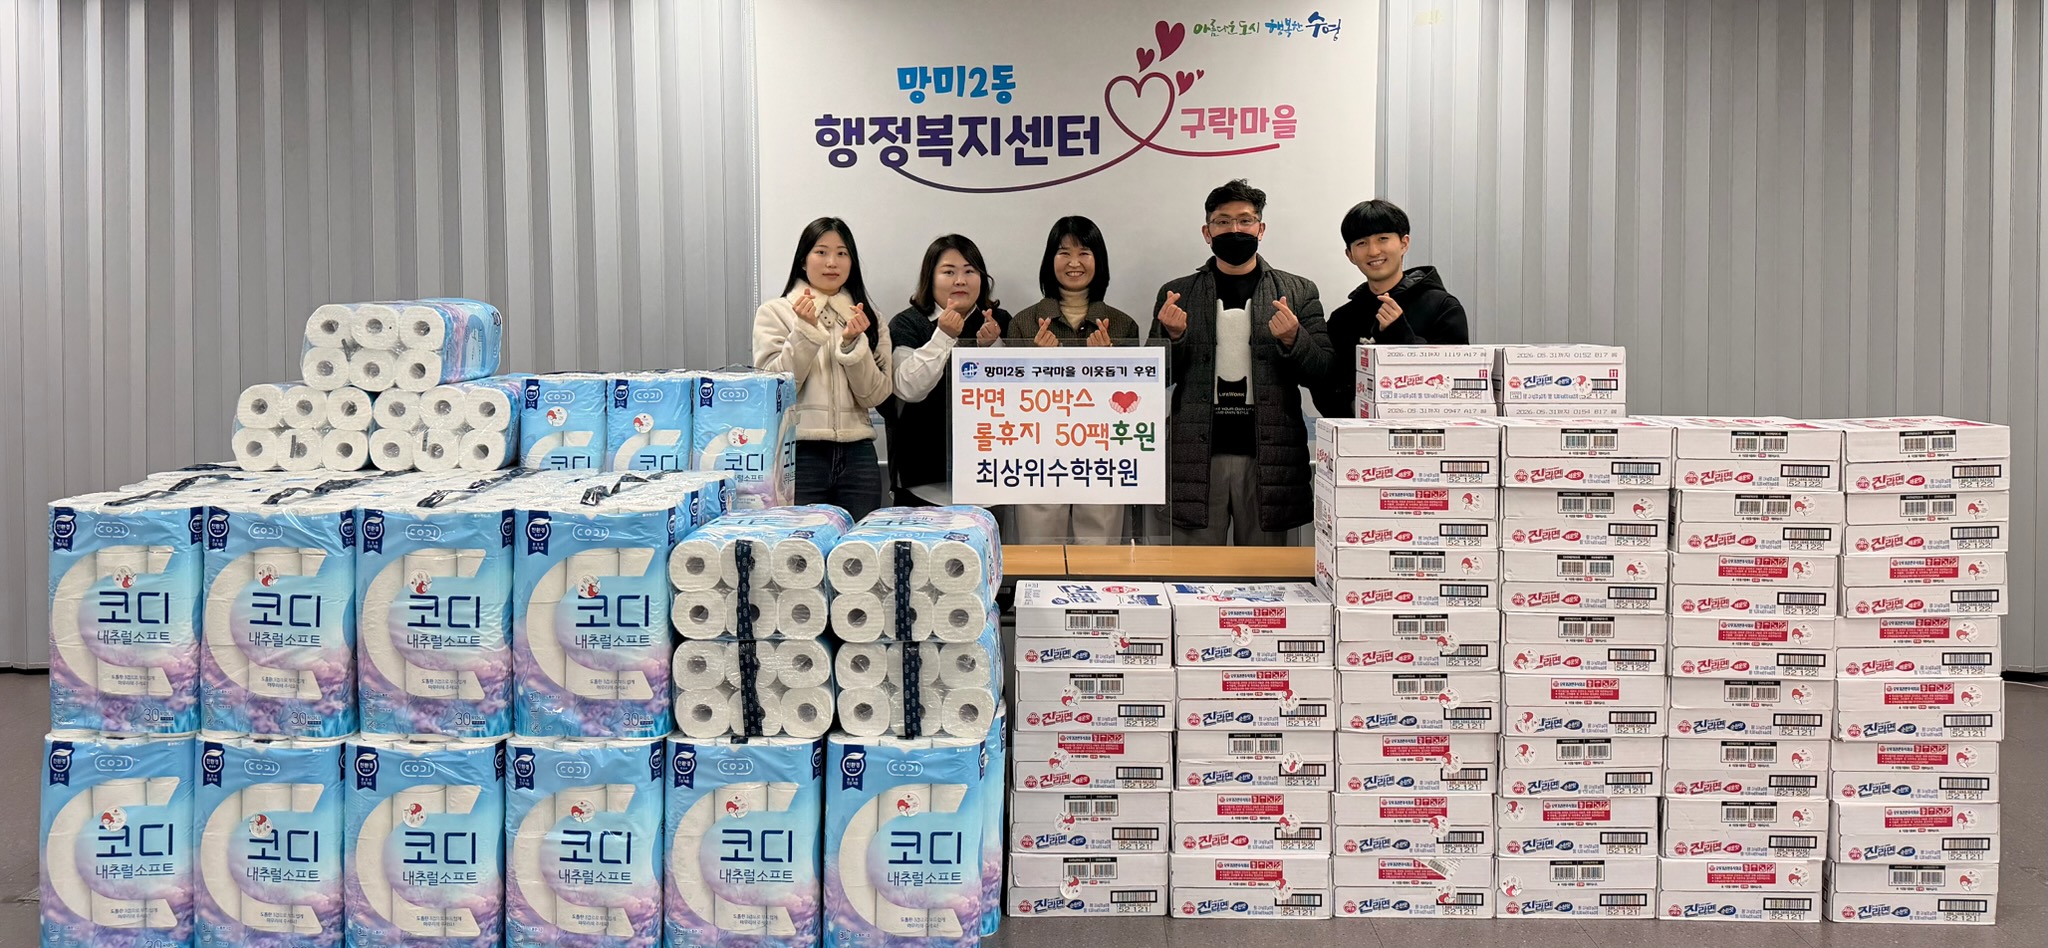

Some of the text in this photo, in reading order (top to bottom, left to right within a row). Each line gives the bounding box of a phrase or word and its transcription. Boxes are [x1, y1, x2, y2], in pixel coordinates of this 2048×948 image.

[1239, 21, 1260, 35] 도시
[1265, 18, 1303, 37] 행복한
[1306, 11, 1341, 41] 수영
[897, 65, 1016, 104] 망미2동
[1180, 104, 1297, 140] 구락마을
[815, 114, 1100, 168] 행정복지센터
[985, 366, 1157, 378] 망미2동 구락마을 이웃돕기 후원
[962, 388, 1095, 417] 라면 50박스
[973, 421, 1039, 451] 롤휴지
[725, 453, 764, 471] 코디
[977, 458, 1138, 487] 최상위수학학원
[1361, 467, 1393, 482] 진라면
[1530, 467, 1564, 483] 진라면
[1700, 470, 1733, 485] 진라면
[1872, 474, 1905, 490] 진라면
[1361, 530, 1393, 544] 진라면
[1528, 529, 1560, 544] 진라면
[1704, 534, 1736, 549] 진라면
[1871, 536, 1903, 551] 진라면
[1361, 590, 1393, 605] 진라면
[1527, 592, 1560, 607] 진라면
[98, 591, 169, 624] 코디
[250, 592, 320, 628] 코디
[408, 594, 480, 628] 코디
[576, 594, 649, 628] 코디
[1697, 598, 1730, 613] 진라면
[1871, 599, 1904, 614] 진라면
[98, 630, 171, 645] 내추럴소프트
[249, 632, 322, 647] 내추럴소프트
[407, 634, 480, 648] 내추럴소프트
[576, 634, 651, 648] 내추럴소프트
[1040, 648, 1071, 663] 진라면
[1201, 647, 1232, 662] 진라면
[1362, 651, 1394, 666] 진라면
[1697, 659, 1730, 674] 진라면
[1861, 660, 1894, 676] 진라면
[144, 708, 159, 722] 30
[291, 711, 306, 725] 30
[455, 712, 470, 726] 30
[623, 712, 638, 726] 30
[1042, 711, 1073, 726] 진라면
[1203, 711, 1234, 726] 진라면
[1366, 714, 1398, 729] 진라면
[1693, 720, 1726, 734] 진라면
[1863, 722, 1896, 737] 진라면
[1039, 774, 1071, 788] 진라면
[1202, 771, 1234, 786] 진라면
[1363, 775, 1395, 790] 진라면
[1527, 780, 1559, 794] 진라면
[1690, 781, 1722, 795] 진라면
[1858, 783, 1891, 798] 진라면
[403, 831, 476, 864] 코디
[559, 830, 632, 864] 코디
[720, 829, 792, 863] 코디
[888, 831, 961, 865] 코디
[1035, 834, 1067, 849] 진라면
[1198, 835, 1229, 849] 진라면
[1359, 838, 1391, 853] 진라면
[1522, 839, 1554, 854] 진라면
[1690, 842, 1722, 855] 진라면
[1864, 846, 1896, 860] 진라면
[96, 863, 175, 879] 내추럴소프트
[246, 867, 320, 882] 내추럴소프트
[402, 870, 478, 886] 내추럴소프트
[559, 869, 632, 885] 내추럴소프트
[720, 870, 794, 884] 내추럴소프트
[888, 872, 962, 886] 내추럴소프트
[1034, 899, 1065, 914] 진라면
[1197, 900, 1229, 915] 진라면
[1358, 899, 1390, 914] 진라면
[1521, 901, 1553, 915] 진라면
[1684, 904, 1716, 918] 진라면
[1857, 905, 1890, 920] 진라면
